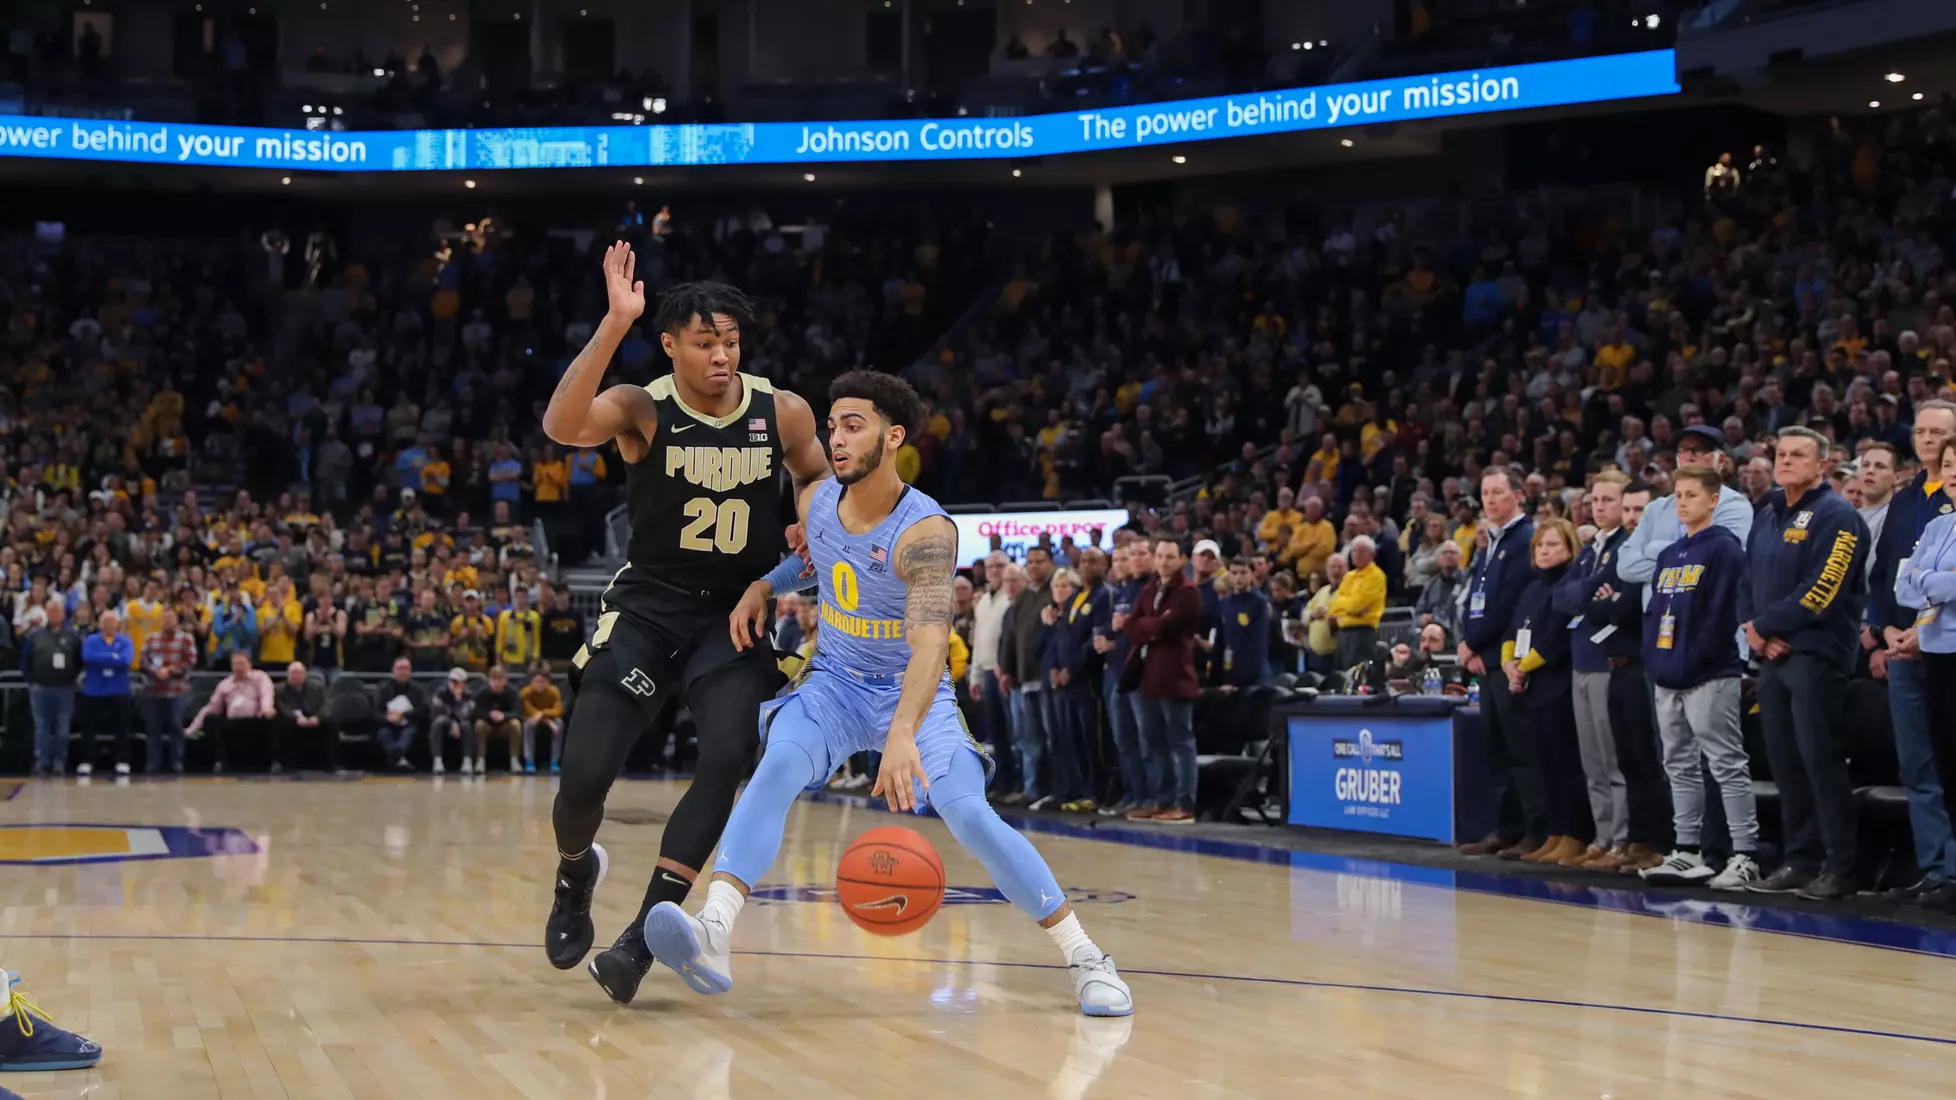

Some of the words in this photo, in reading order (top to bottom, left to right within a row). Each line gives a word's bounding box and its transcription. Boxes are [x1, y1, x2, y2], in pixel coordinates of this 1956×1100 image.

[1077, 112, 1127, 141] The
[1135, 106, 1219, 143] power
[1226, 91, 1317, 129] behind
[1326, 88, 1393, 125] your
[1402, 73, 1520, 111] mission
[72, 121, 168, 154] behind
[177, 130, 246, 162] your
[255, 131, 367, 163] mission
[796, 125, 910, 154] Johnson
[919, 122, 1034, 152] Controls
[665, 445, 773, 493] PURDUE
[679, 497, 751, 555] 20
[978, 520, 1041, 537] Office
[832, 560, 859, 612] 0
[820, 599, 903, 640] MARQUETTE
[1335, 767, 1401, 805] GRUBER
